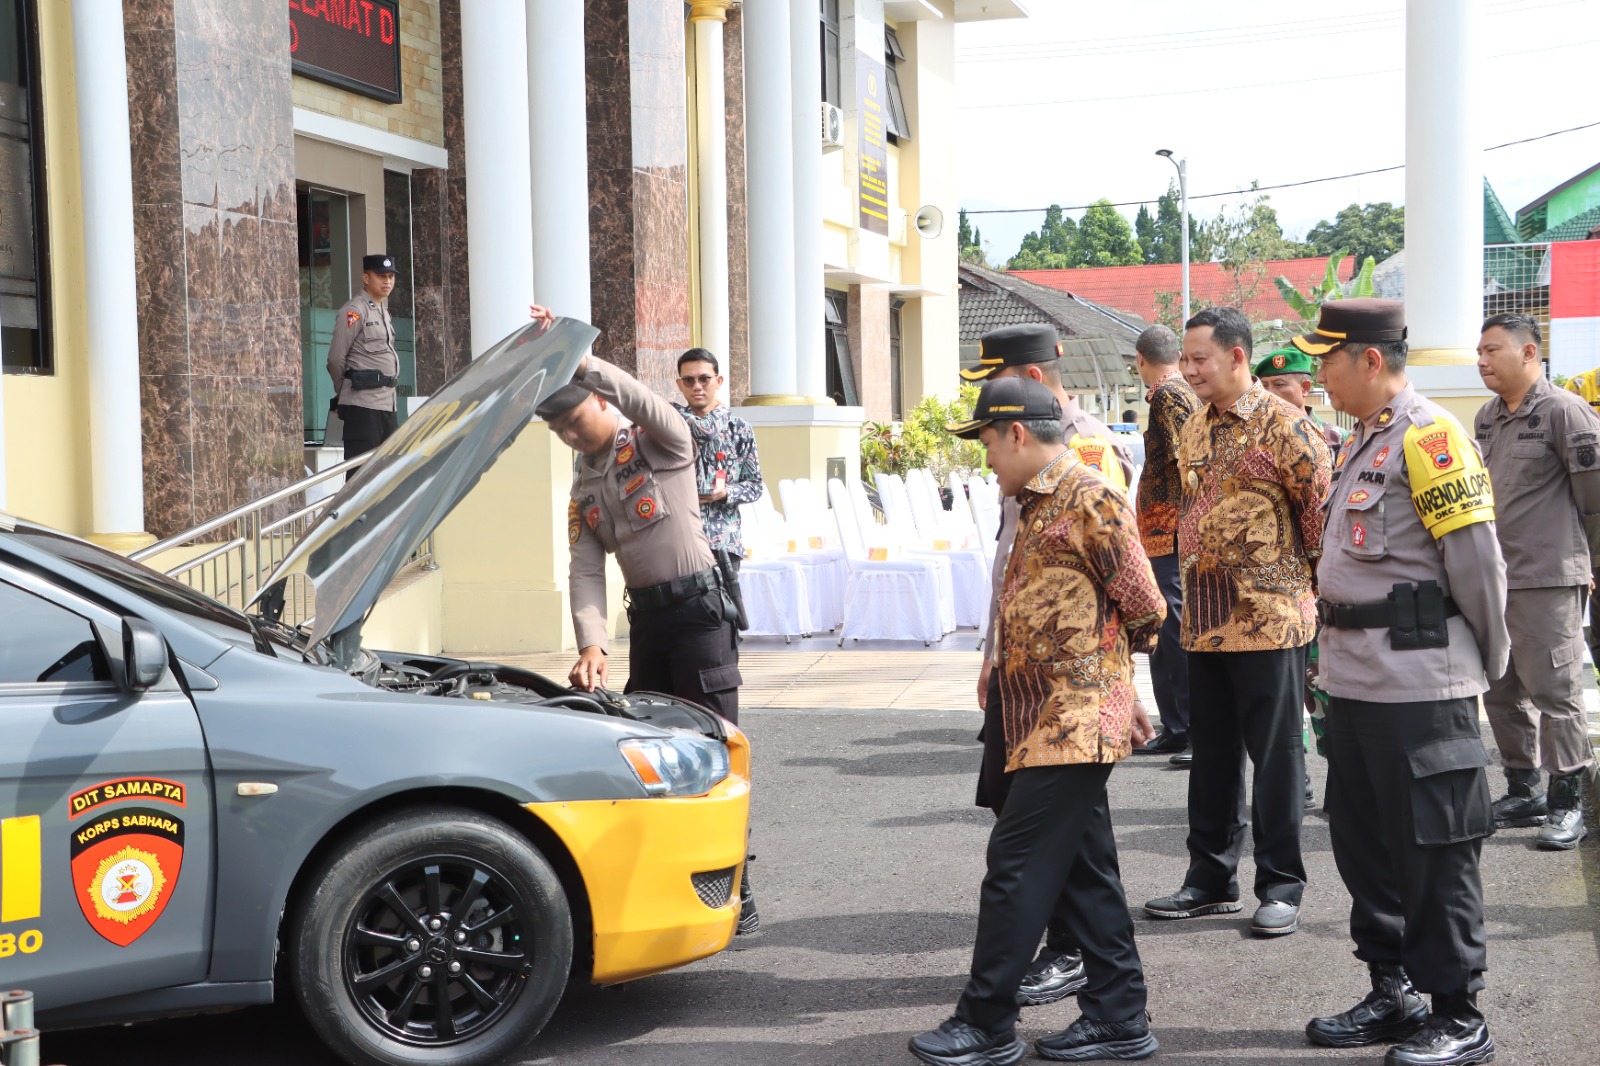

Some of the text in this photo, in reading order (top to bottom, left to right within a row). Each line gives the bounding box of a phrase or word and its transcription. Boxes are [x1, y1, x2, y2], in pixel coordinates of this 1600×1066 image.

[616, 459, 648, 483] POLRI
[1358, 470, 1386, 486] POLRI
[1412, 472, 1492, 519] KARENDALOPS
[1434, 506, 1456, 520] OKC
[73, 781, 182, 812] DIT SAMAPTA
[77, 815, 178, 844] KORPS SABHARA
[0, 929, 43, 958] BO
